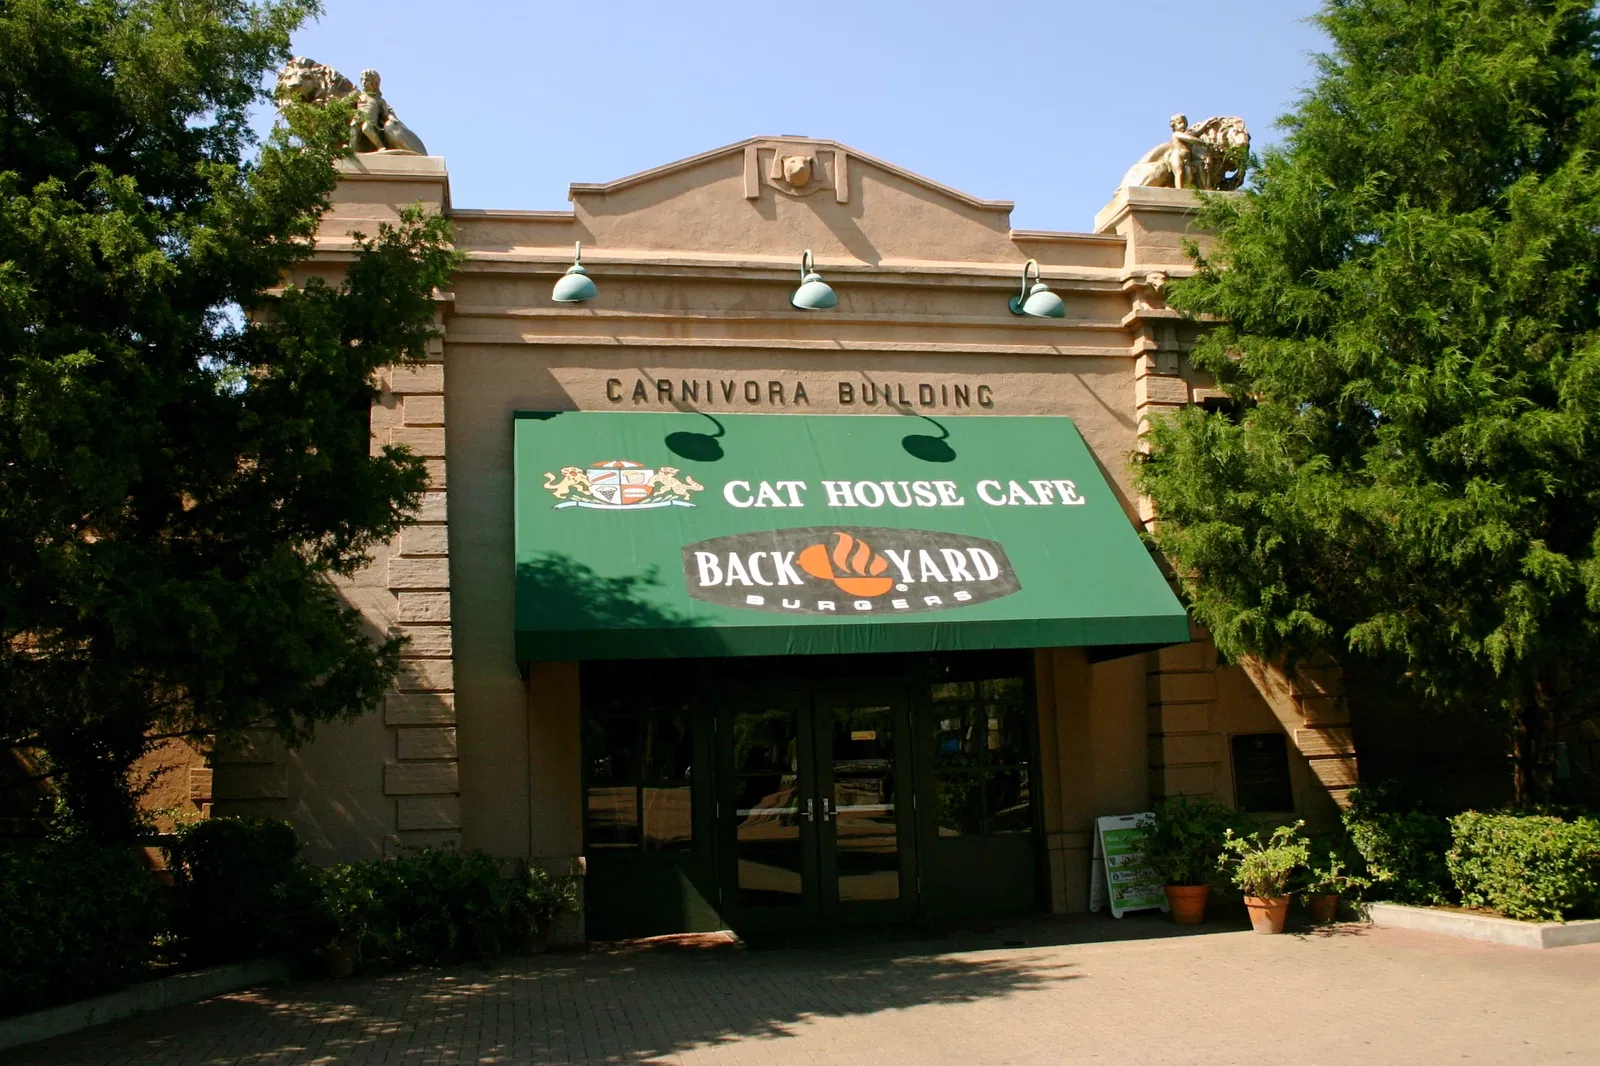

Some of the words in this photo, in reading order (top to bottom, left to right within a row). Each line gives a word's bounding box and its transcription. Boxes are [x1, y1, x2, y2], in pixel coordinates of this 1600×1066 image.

[606, 378, 809, 405] CARNIVORA
[838, 381, 994, 407] BUILDING
[723, 480, 806, 508] CAT
[822, 481, 965, 507] HOUSE
[976, 480, 1085, 506] CAFE
[694, 550, 804, 587] BACK
[884, 547, 999, 584] YARD
[746, 590, 973, 611] BURGERS
